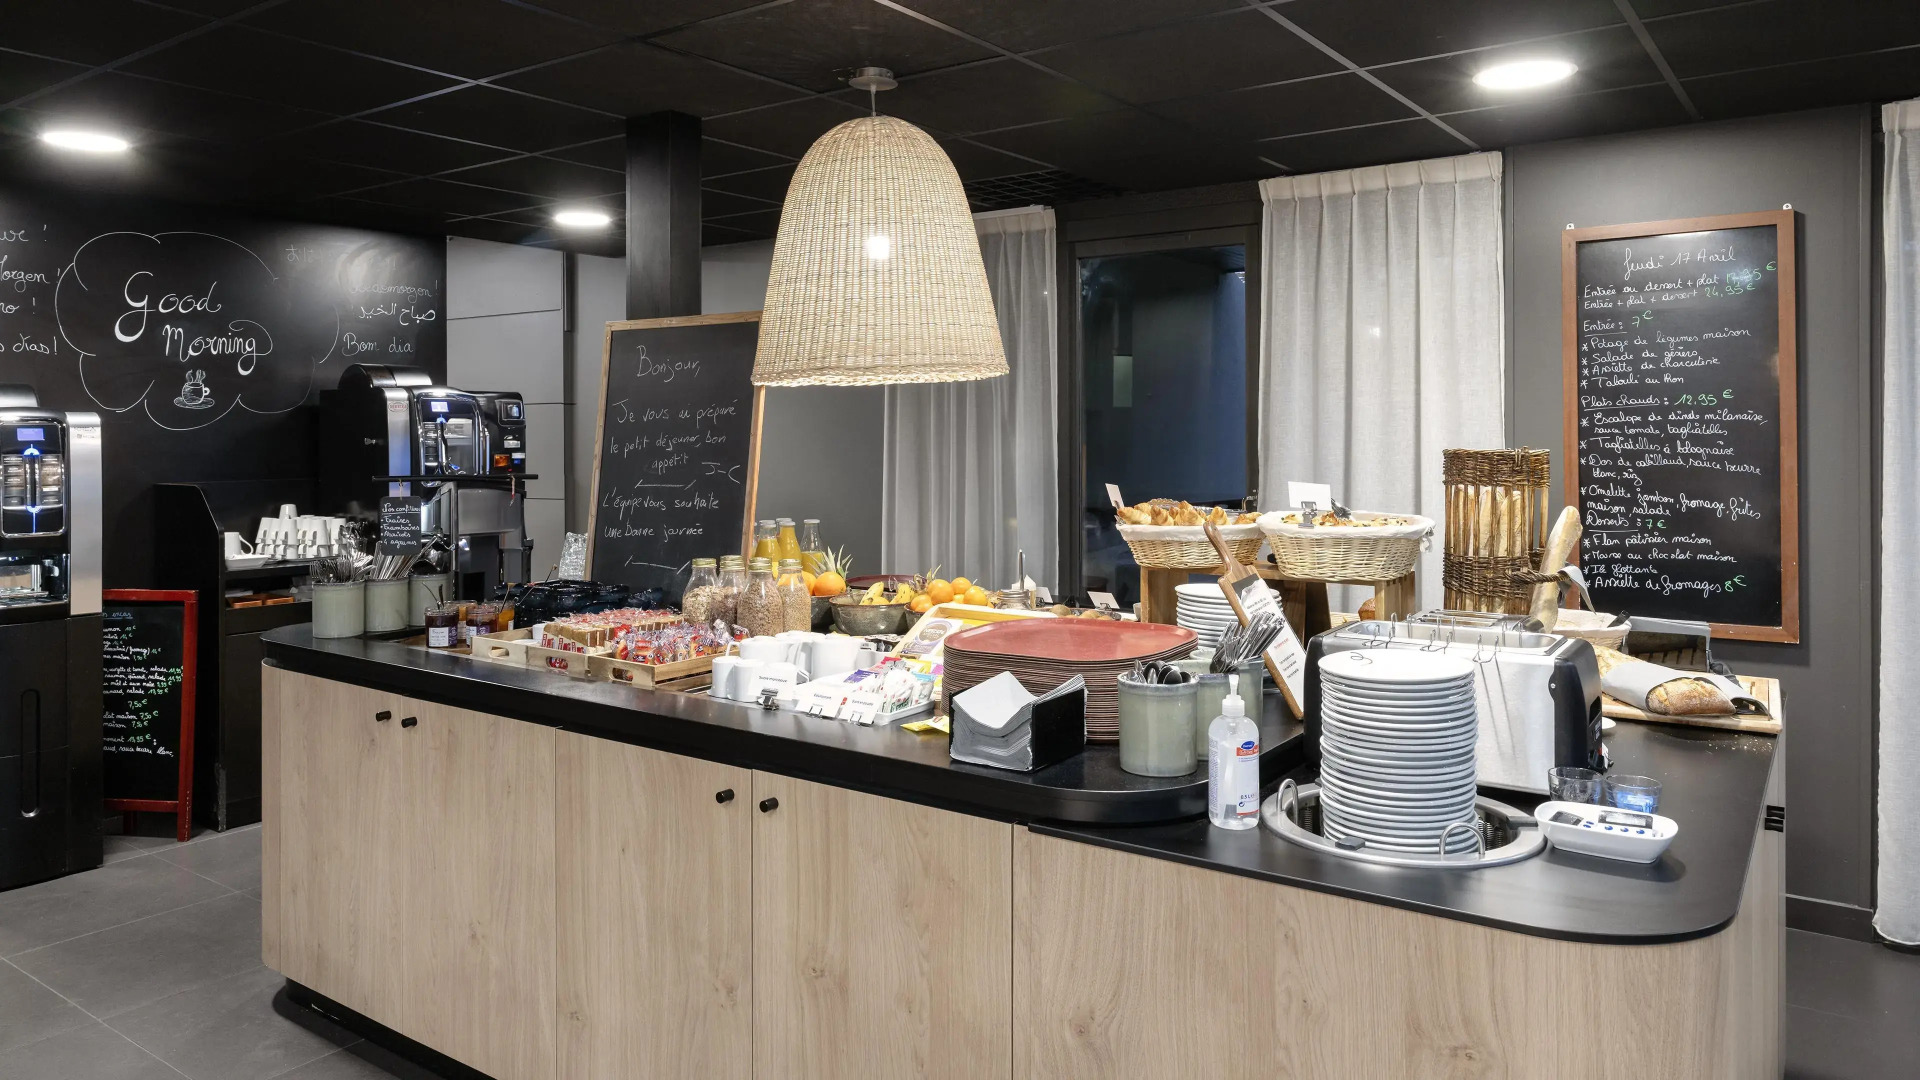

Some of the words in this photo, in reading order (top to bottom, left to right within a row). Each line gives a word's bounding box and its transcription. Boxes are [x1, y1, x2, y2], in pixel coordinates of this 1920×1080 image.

[1670, 252, 1690, 266] 17
[1583, 284, 1617, 298] Entrée
[1622, 285, 1639, 294] ou
[1696, 273, 1720, 289] plat
[114, 271, 222, 342] Good
[1584, 298, 1614, 310] Entrée
[1626, 295, 1647, 308] plat
[388, 336, 414, 353] dia
[1590, 336, 1629, 352] Potage
[1634, 336, 1648, 345] de
[1702, 327, 1752, 341] maison
[162, 319, 273, 376] Morning
[1591, 351, 1634, 365] Salade
[1642, 349, 1658, 358] de
[1640, 361, 1656, 370] de
[1580, 395, 1613, 408] Plats
[612, 398, 635, 424] Je
[642, 406, 670, 422] vous
[1593, 411, 1642, 425] Escalope
[1648, 412, 1663, 421] de
[1593, 426, 1622, 434] sauce
[610, 436, 619, 455] le
[624, 435, 650, 459] petit
[705, 430, 726, 444] bon
[1588, 453, 1613, 467] Dos
[1617, 457, 1632, 467] de
[1689, 458, 1722, 470] sauce
[1588, 482, 1631, 498] Omelette
[674, 490, 719, 510] souhaite
[1632, 503, 1672, 517] salade
[604, 524, 622, 538] une
[1592, 533, 1621, 546] Flan
[1671, 532, 1712, 546] maison
[1696, 550, 1738, 563] maison
[1646, 578, 1661, 590] de
